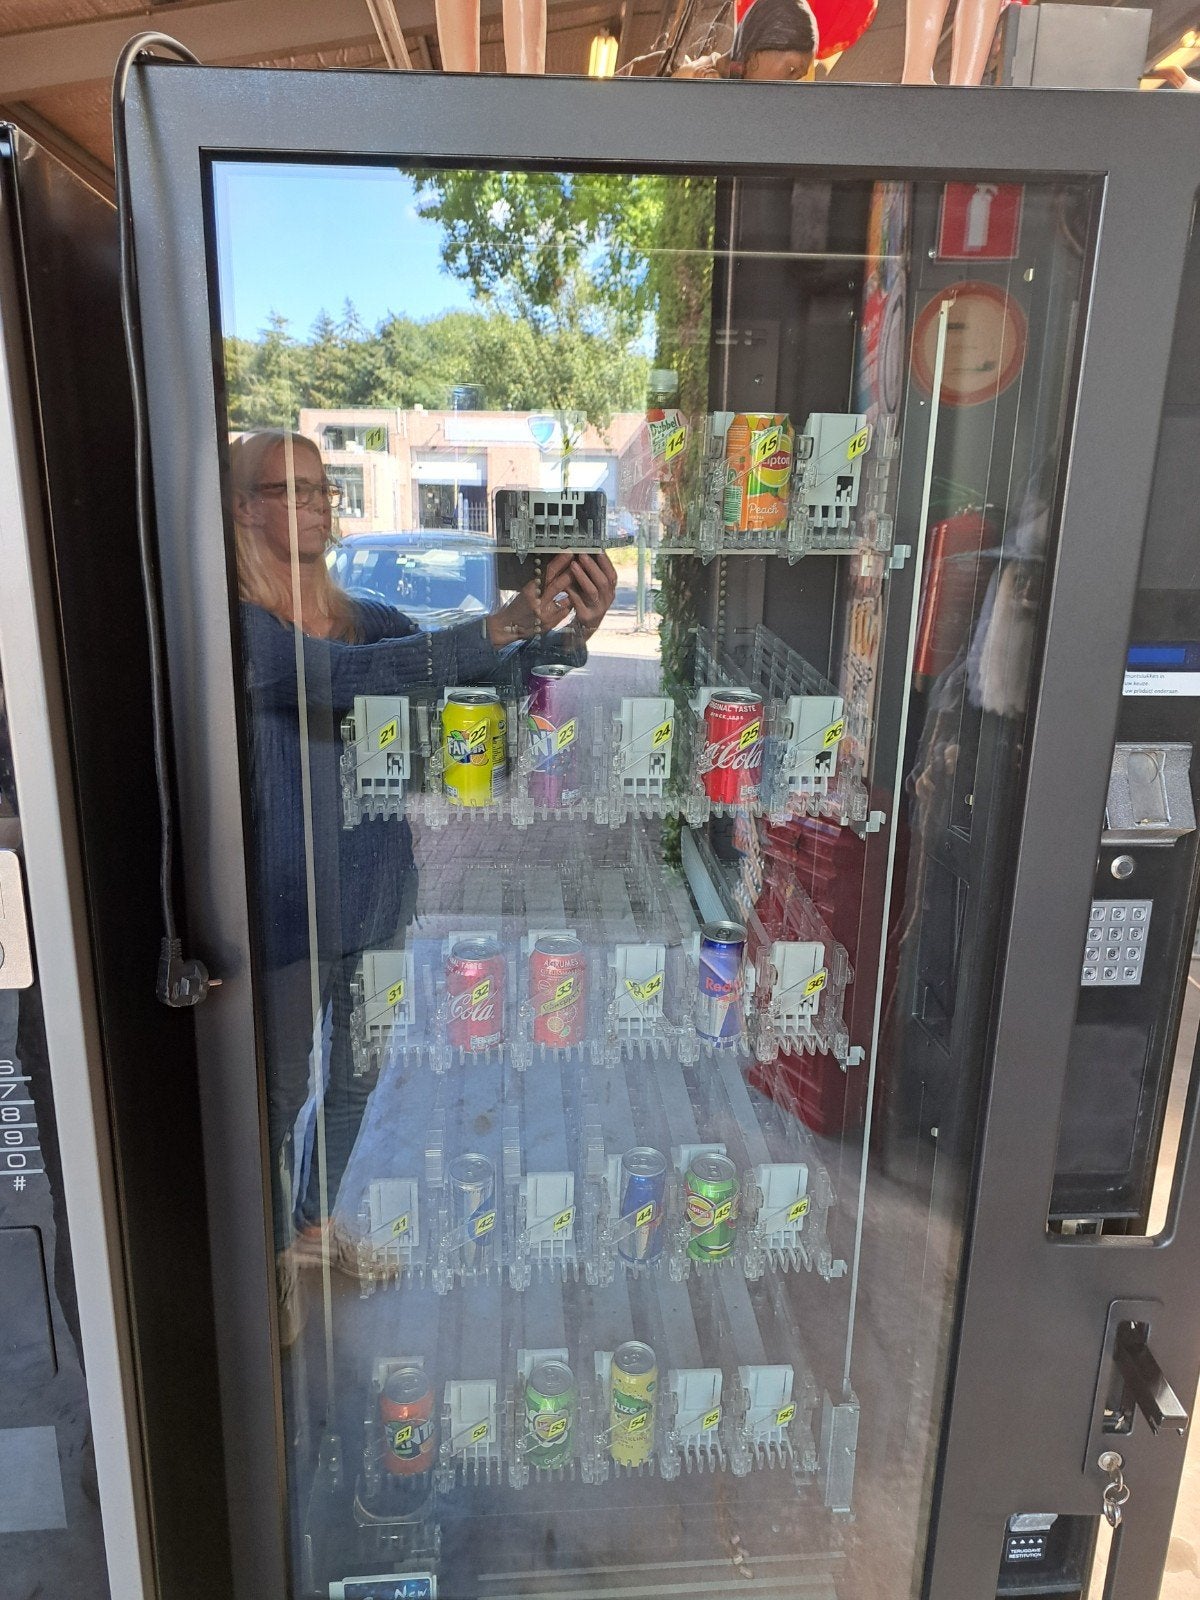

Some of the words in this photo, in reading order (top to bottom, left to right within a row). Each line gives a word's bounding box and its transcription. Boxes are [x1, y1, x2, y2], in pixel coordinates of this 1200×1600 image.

[668, 431, 684, 452] 14
[760, 434, 777, 455] 15
[850, 437, 866, 453] 16
[748, 502, 778, 514] Peach
[735, 704, 757, 713] TASTE
[380, 725, 395, 743] 21
[470, 725, 486, 744] 22
[558, 724, 574, 745] 23
[654, 725, 671, 744] 24
[740, 725, 758, 746] 25
[825, 724, 842, 743] 26
[474, 983, 489, 1000] 32
[557, 981, 572, 997] 33
[645, 976, 661, 994] 34
[705, 976, 732, 993] Red
[808, 975, 824, 992] 36
[388, 984, 404, 1002] 31
[0, 1060, 15, 1074] 6
[1, 1083, 18, 1099] 7
[1, 1107, 21, 1122] 8
[4, 1130, 23, 1145] 9
[7, 1153, 27, 1168] 0
[13, 1175, 27, 1191] #
[637, 1207, 652, 1222] 44
[716, 1205, 730, 1219] 45
[789, 1203, 807, 1217] 46
[393, 1216, 407, 1232] 41
[477, 1213, 495, 1231] 42
[555, 1213, 571, 1228] 43
[630, 1415, 645, 1429] 54
[704, 1413, 719, 1426] 55
[778, 1410, 794, 1422] 56
[397, 1428, 410, 1441] 51
[472, 1425, 488, 1440] 52
[550, 1420, 566, 1433] 53
